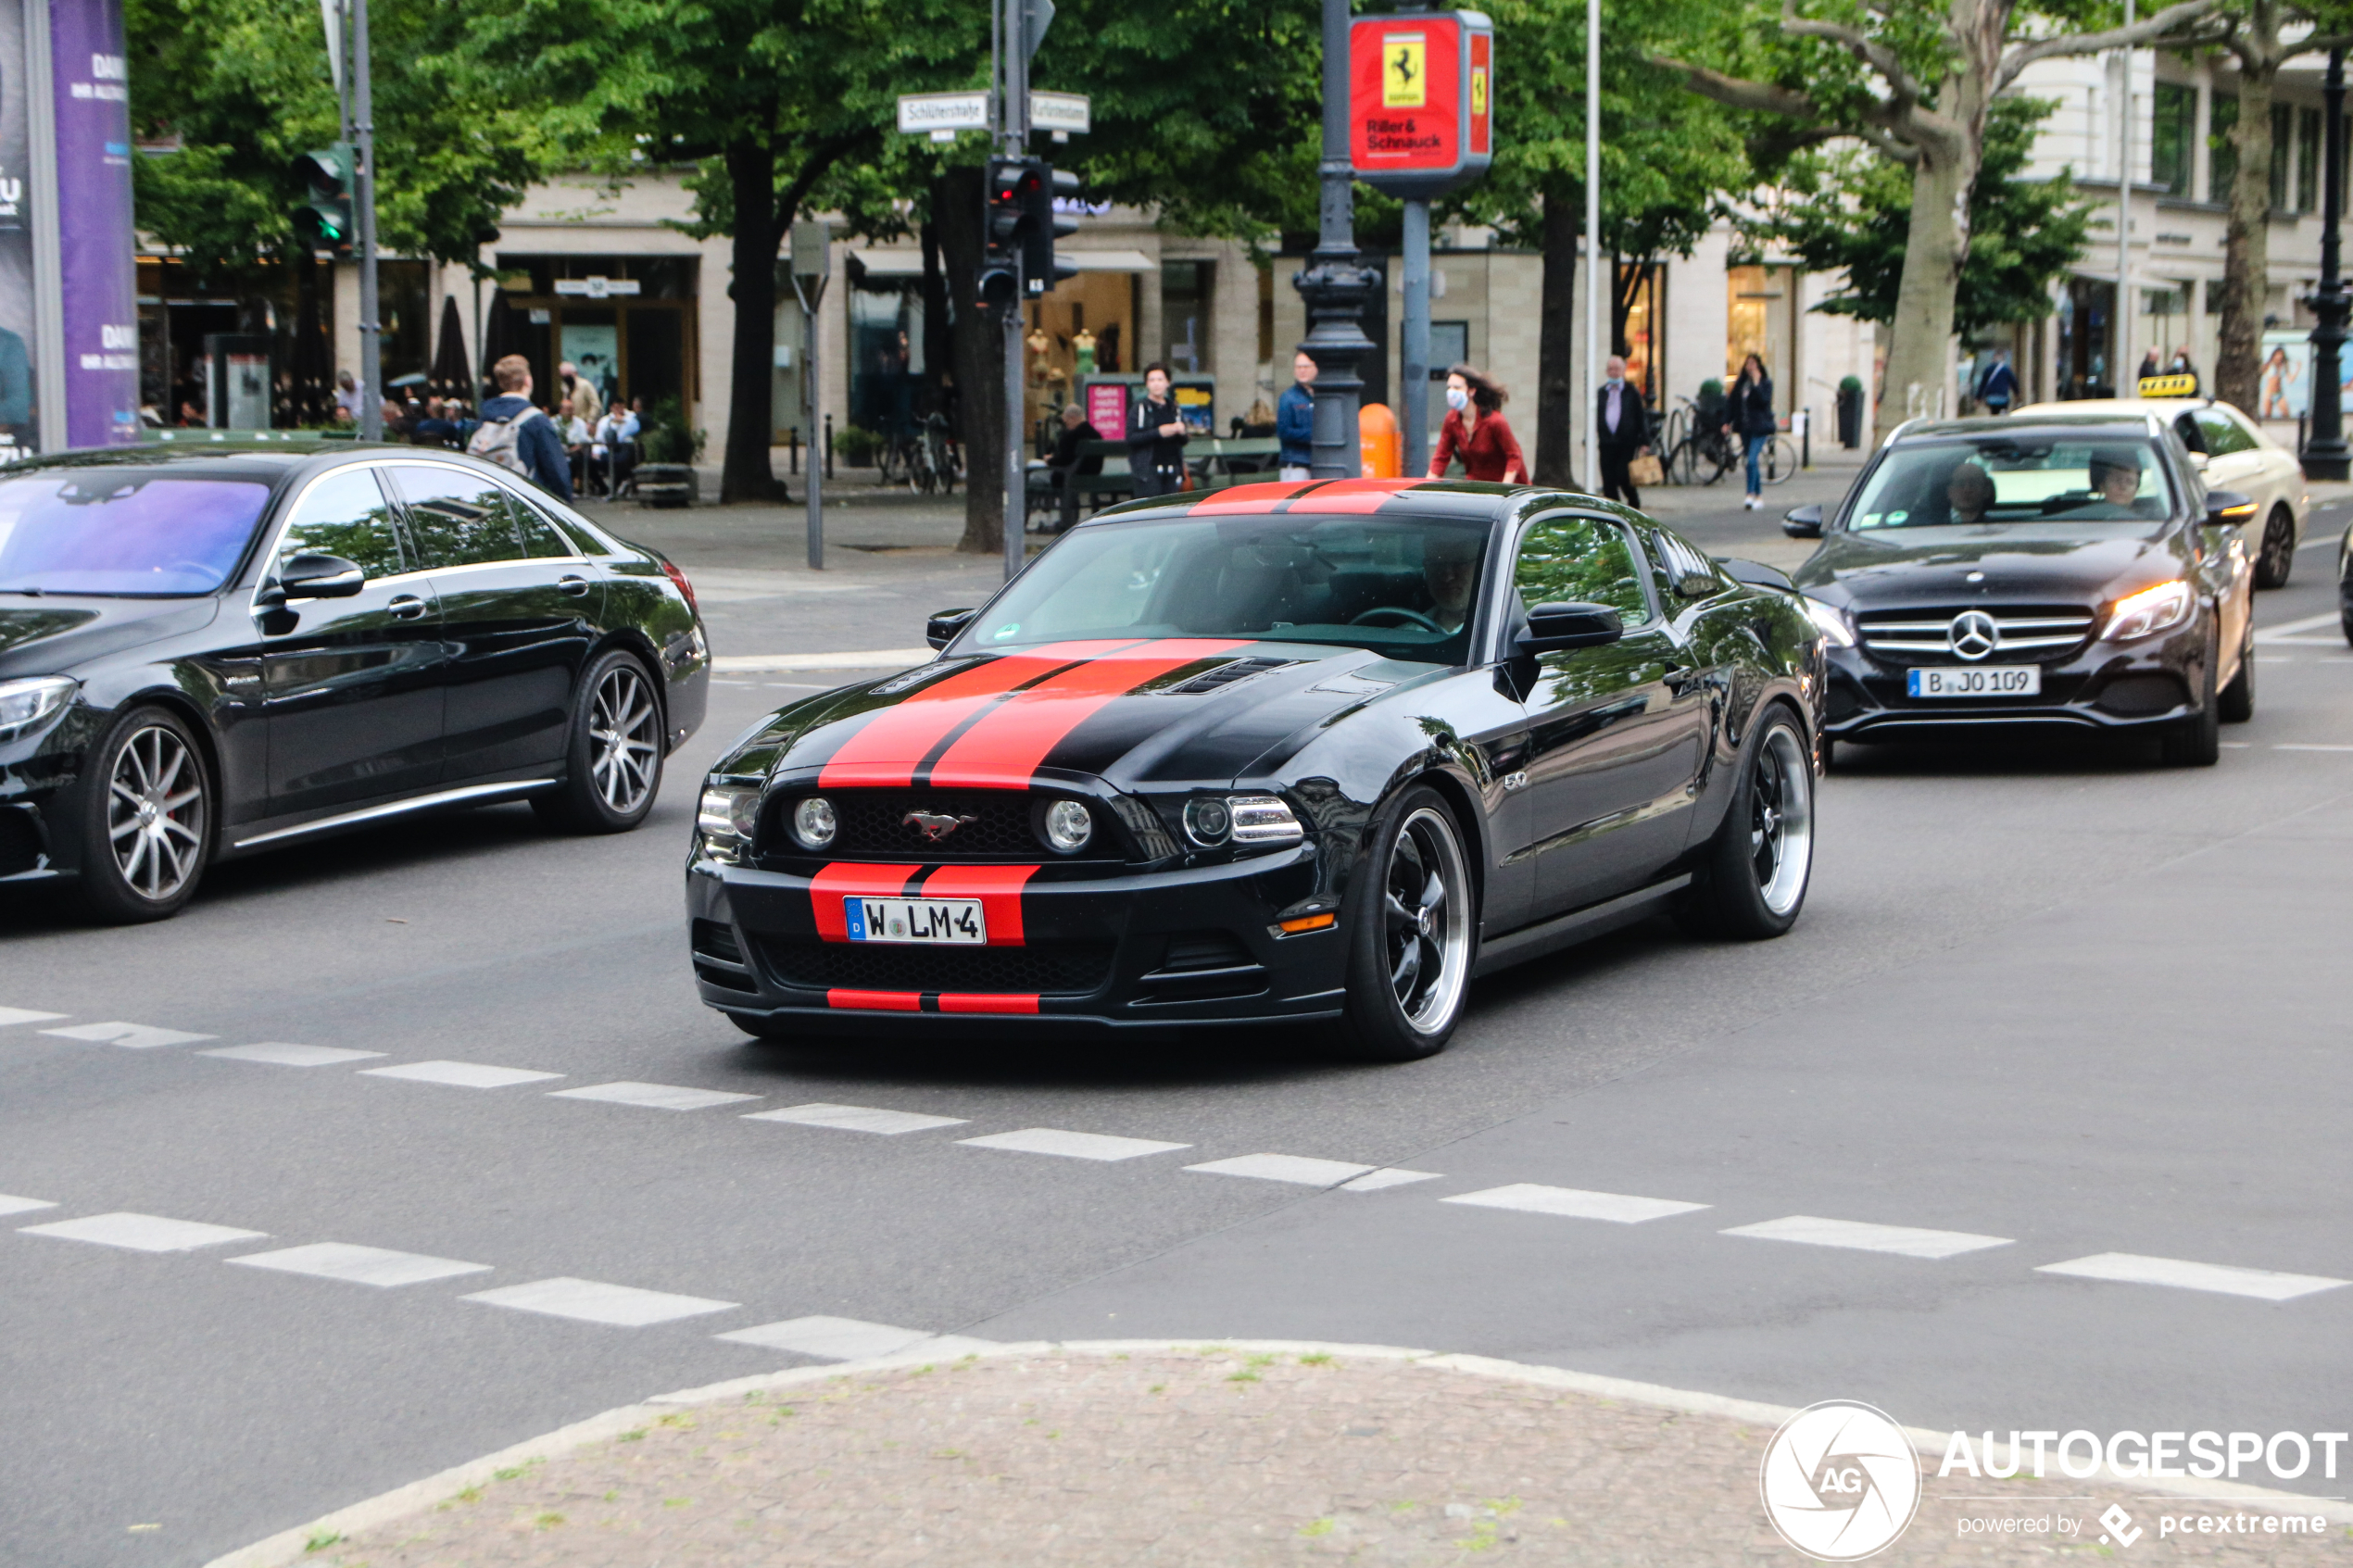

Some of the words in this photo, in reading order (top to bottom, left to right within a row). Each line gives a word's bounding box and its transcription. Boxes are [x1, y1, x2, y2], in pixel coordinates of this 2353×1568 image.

[1366, 119, 1403, 132] Riller
[1405, 119, 1416, 133] &
[1367, 134, 1441, 150] Schnauck
[1930, 672, 1942, 693] B
[1957, 671, 1985, 692] JO
[1990, 671, 2029, 691] 109
[852, 922, 861, 933] D
[865, 903, 885, 935] W
[908, 905, 951, 937] LM
[960, 906, 978, 937] 4
